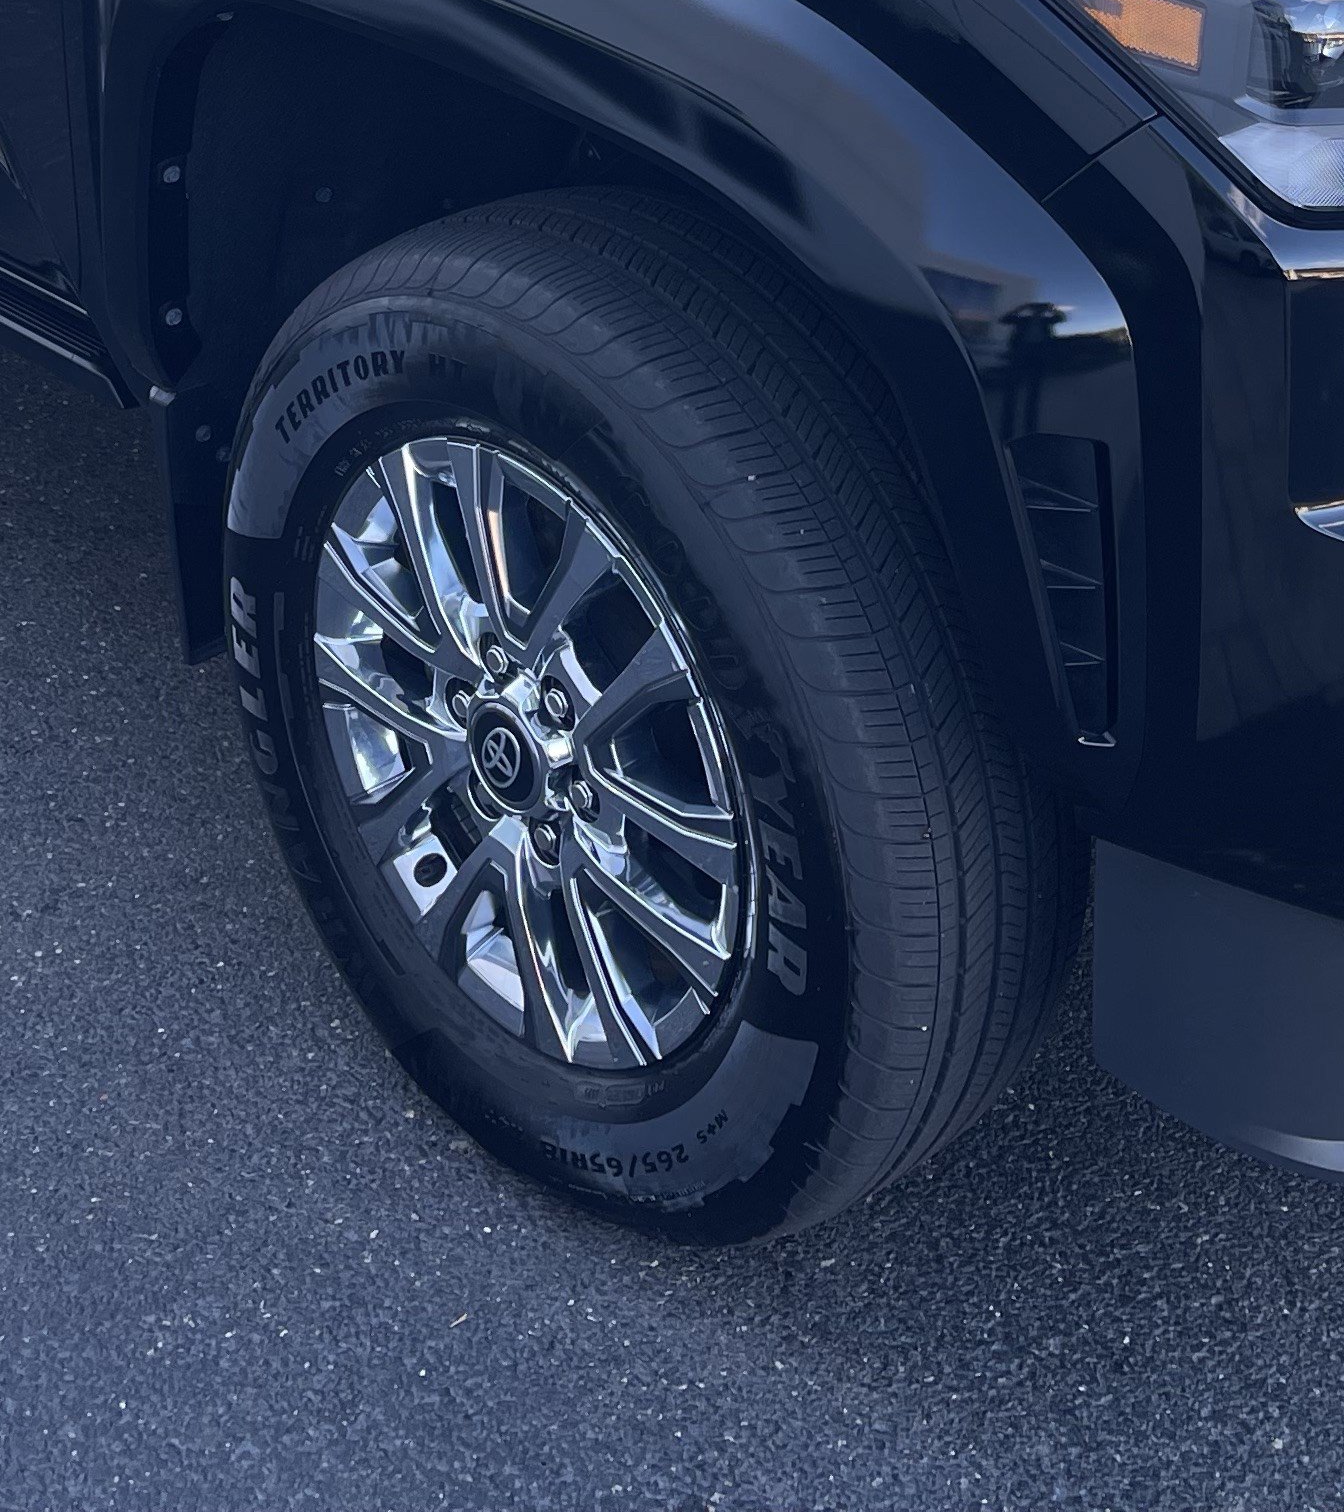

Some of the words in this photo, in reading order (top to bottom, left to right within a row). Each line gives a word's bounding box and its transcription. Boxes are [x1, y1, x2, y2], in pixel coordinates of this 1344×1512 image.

[274, 349, 406, 444] TERRITORY
[696, 1109, 729, 1145] M+S
[542, 1141, 690, 1179] 265/65R18
